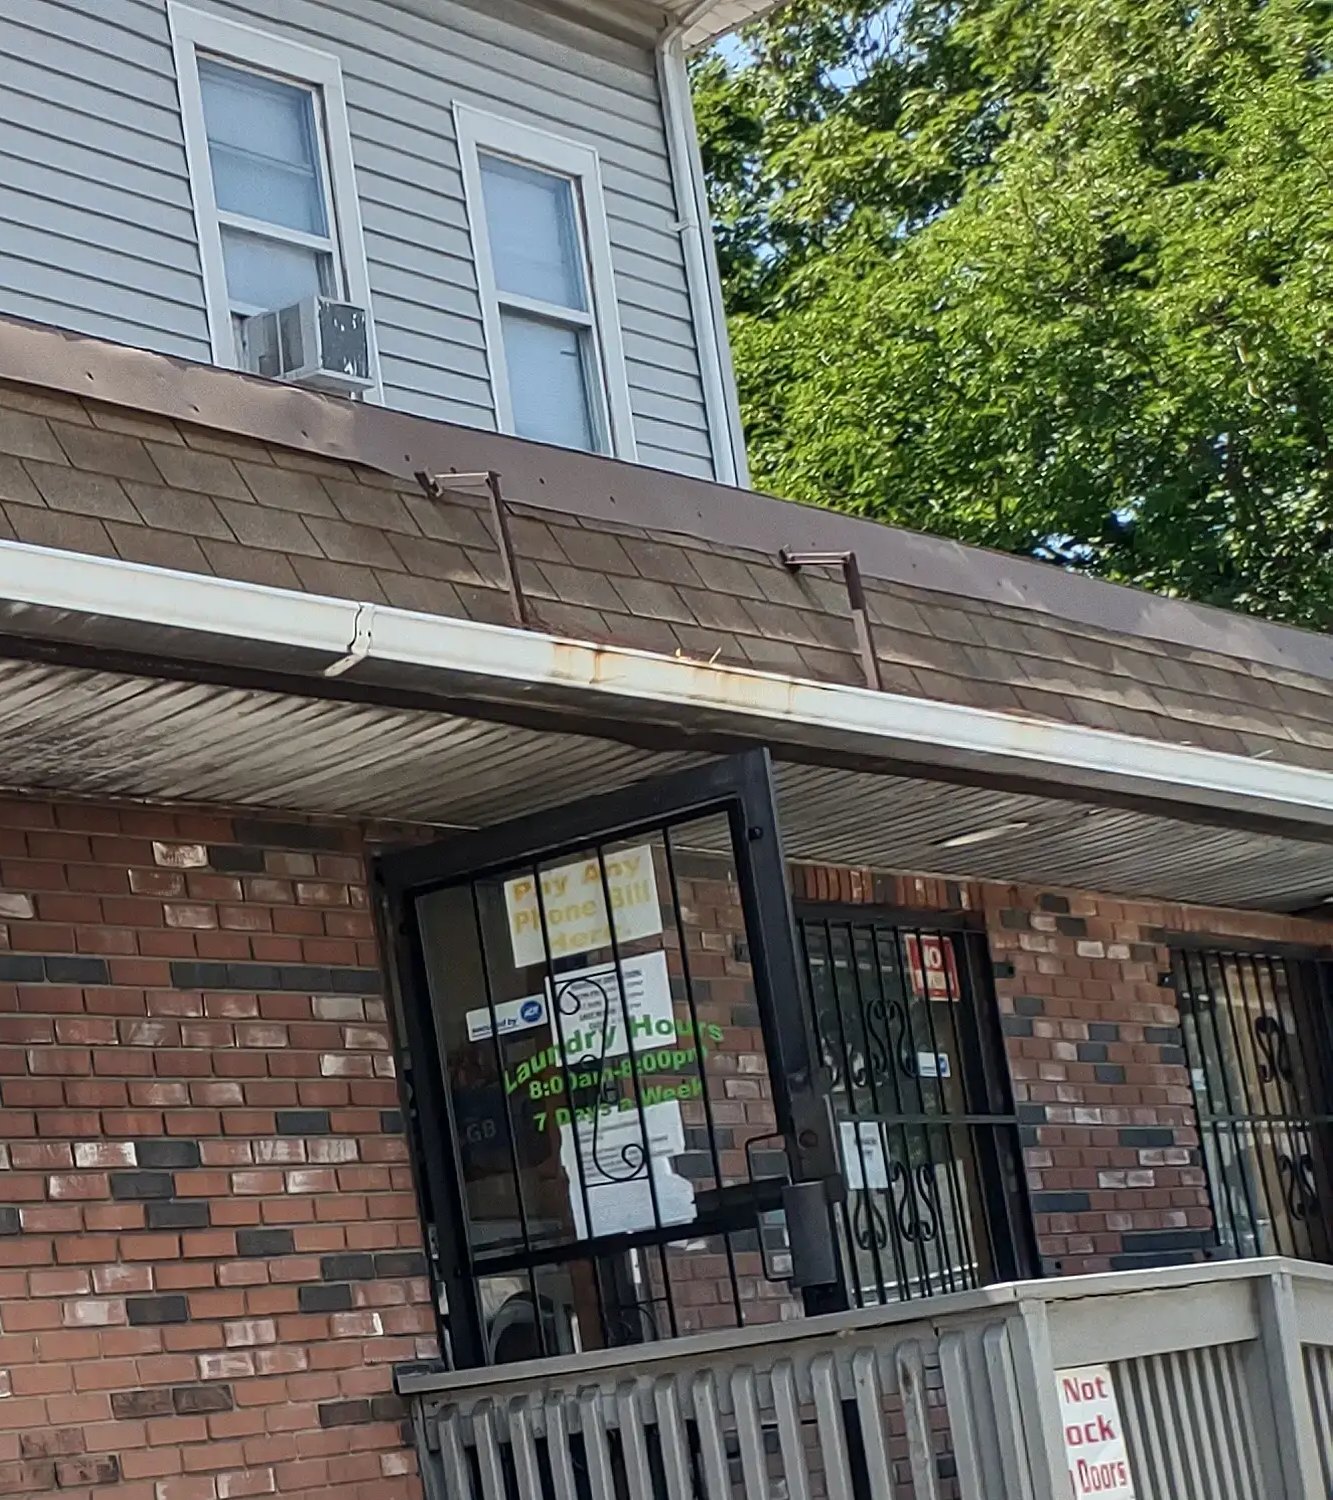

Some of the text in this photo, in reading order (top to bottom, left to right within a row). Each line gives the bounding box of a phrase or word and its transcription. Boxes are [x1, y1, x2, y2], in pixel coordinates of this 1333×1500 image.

[504, 1014, 723, 1095] Laundry Hours
[532, 1078, 702, 1132] 7 Days a Week
[1062, 1375, 1108, 1404] Not
[1077, 1459, 1128, 1494] Doors
